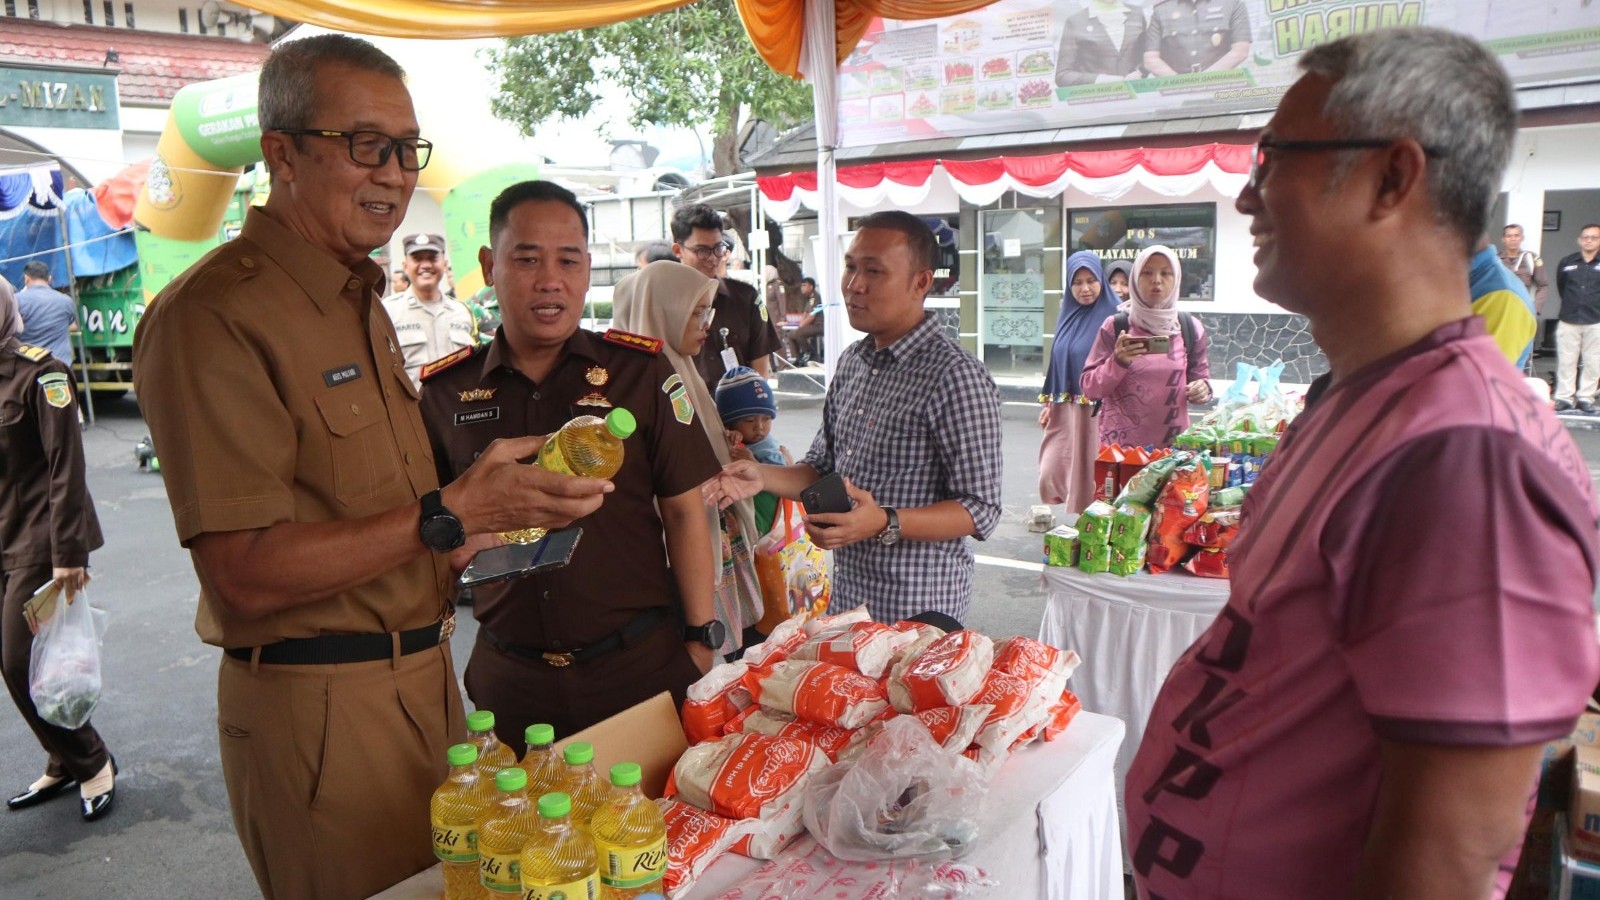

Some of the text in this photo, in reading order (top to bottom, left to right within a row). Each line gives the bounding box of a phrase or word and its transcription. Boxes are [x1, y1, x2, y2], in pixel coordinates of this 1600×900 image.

[198, 115, 244, 136] GERAKAN
[1126, 228, 1156, 240] POS
[466, 411, 489, 420] HAMDAN
